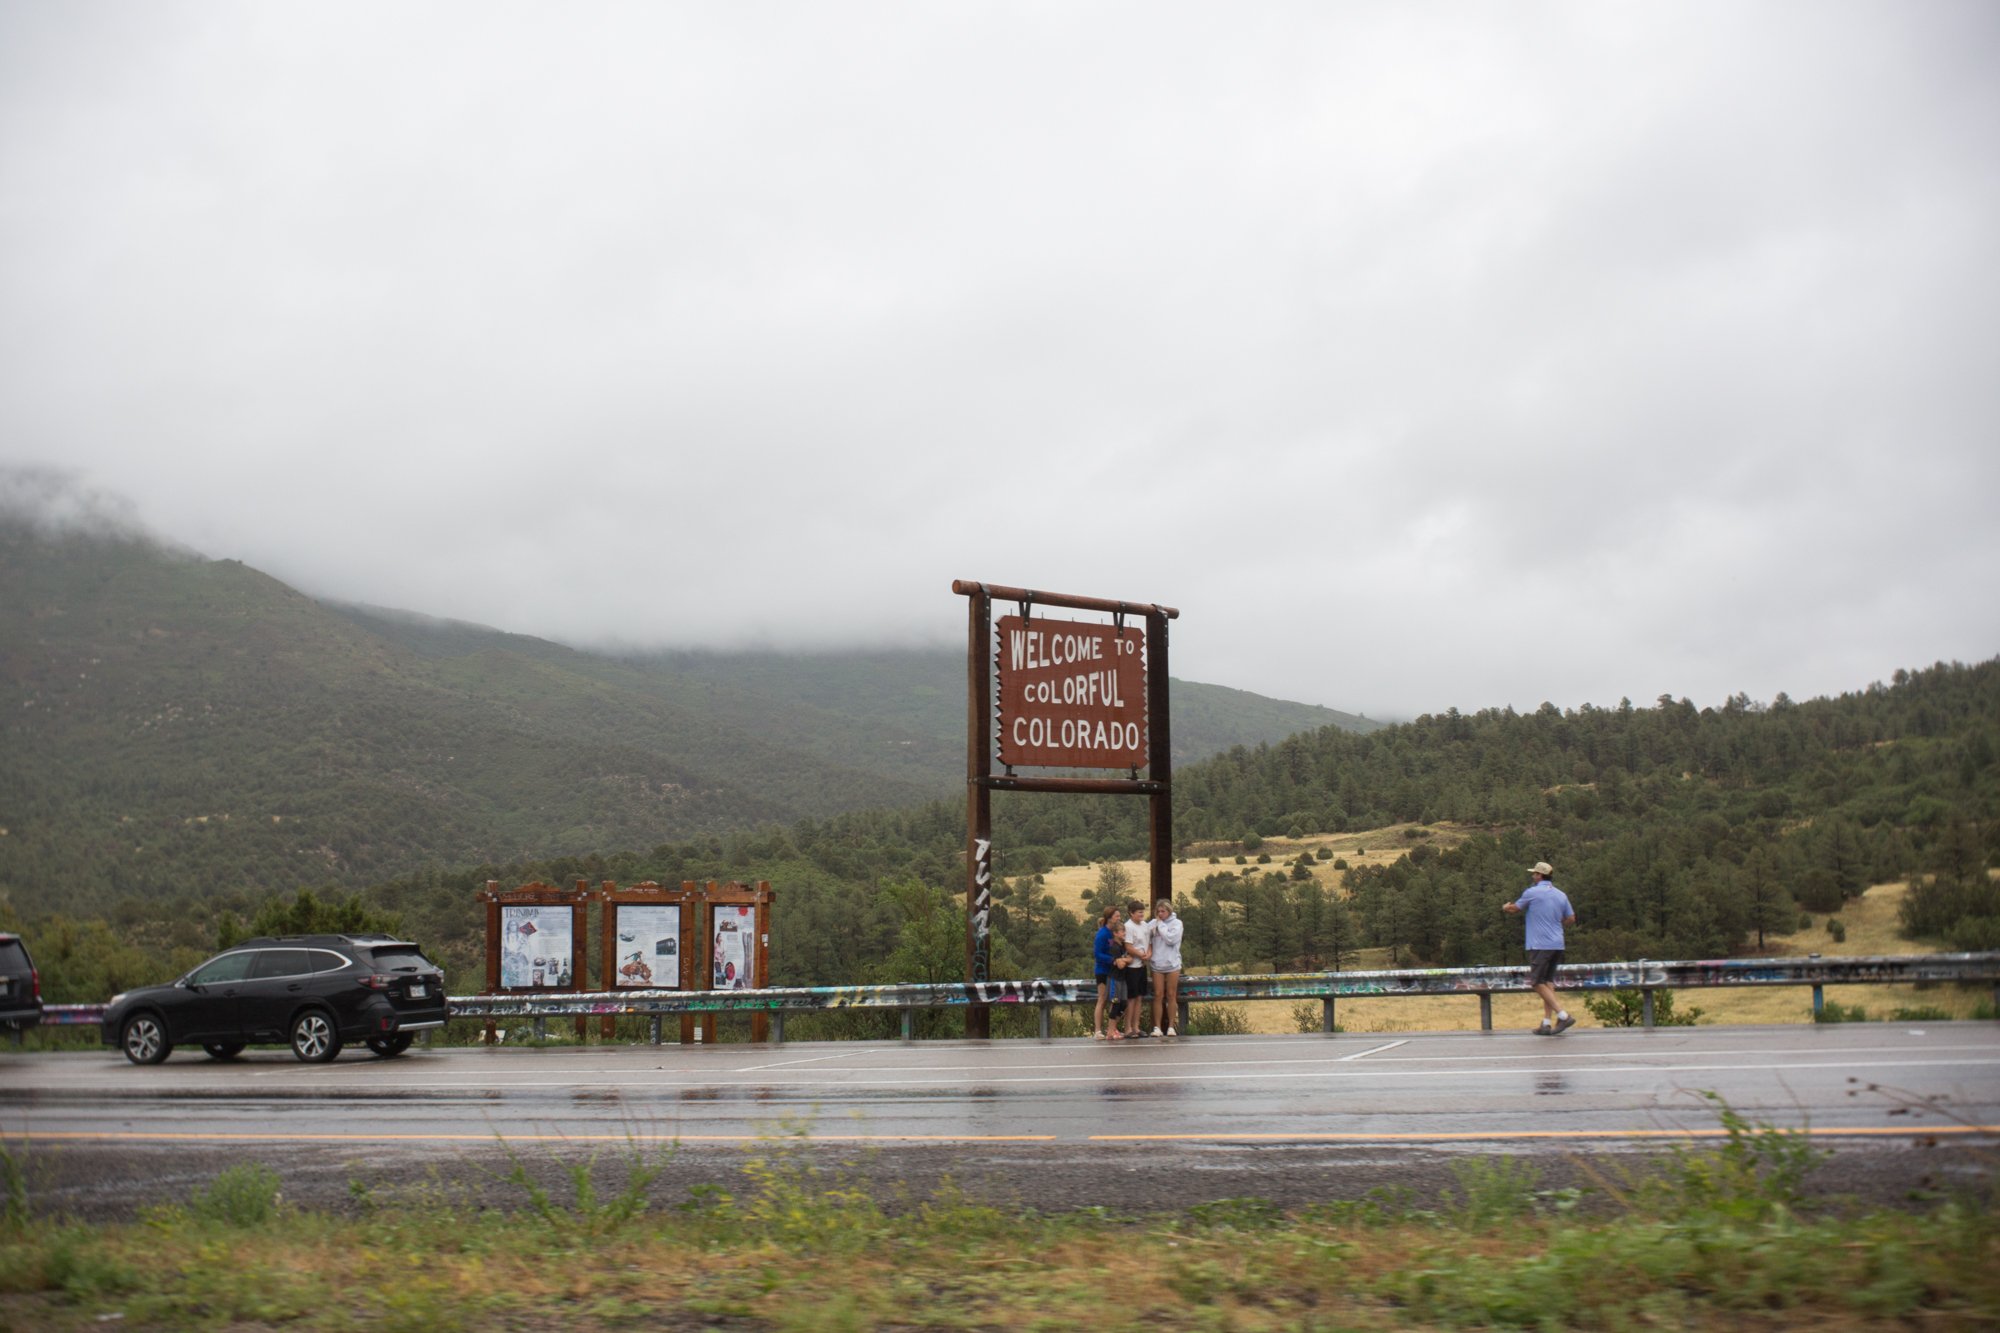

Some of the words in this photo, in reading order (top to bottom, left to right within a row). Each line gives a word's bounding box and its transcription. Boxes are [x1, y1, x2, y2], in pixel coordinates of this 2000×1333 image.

[1010, 630, 1103, 671] WELCOME
[1115, 638, 1135, 656] TO
[1024, 669, 1124, 708] COLORFUL
[1013, 717, 1139, 751] COLORADO
